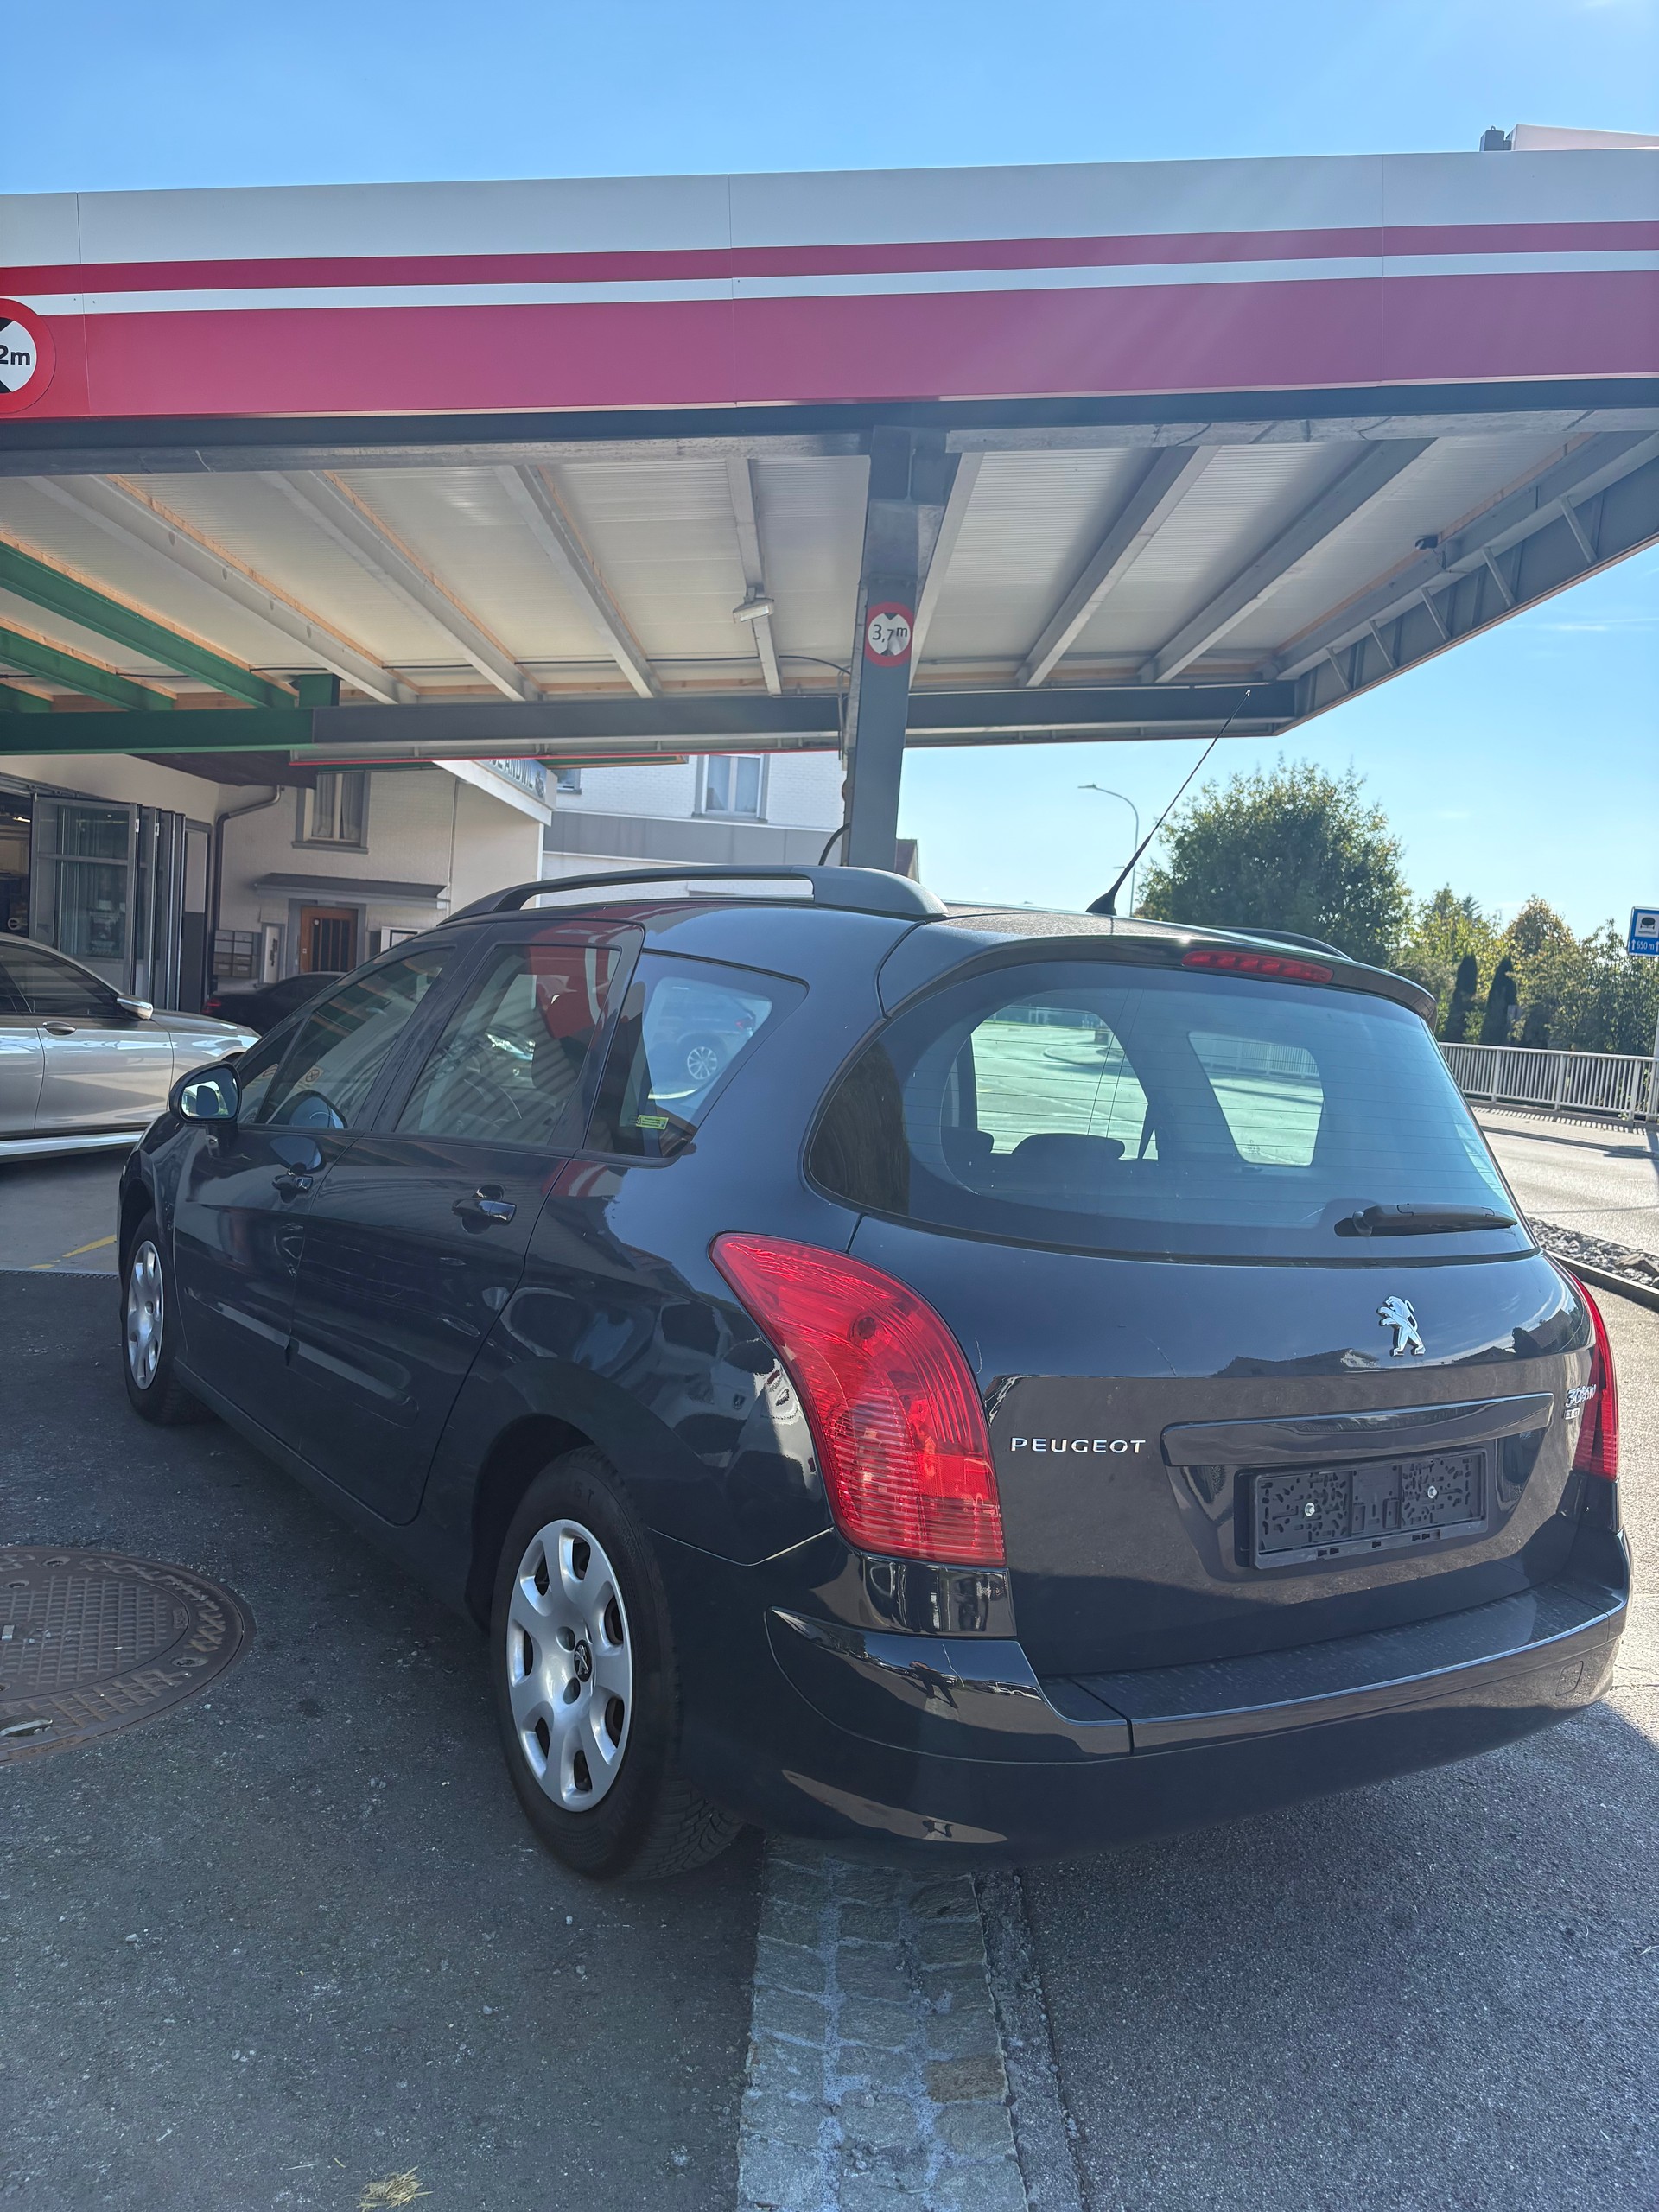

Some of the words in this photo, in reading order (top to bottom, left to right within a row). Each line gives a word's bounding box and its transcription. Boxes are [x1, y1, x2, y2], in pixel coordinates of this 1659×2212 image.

[872, 624, 908, 643] 3,7m
[1636, 940, 1648, 950] 650
[1010, 1437, 1147, 1453] PEUGEOT
